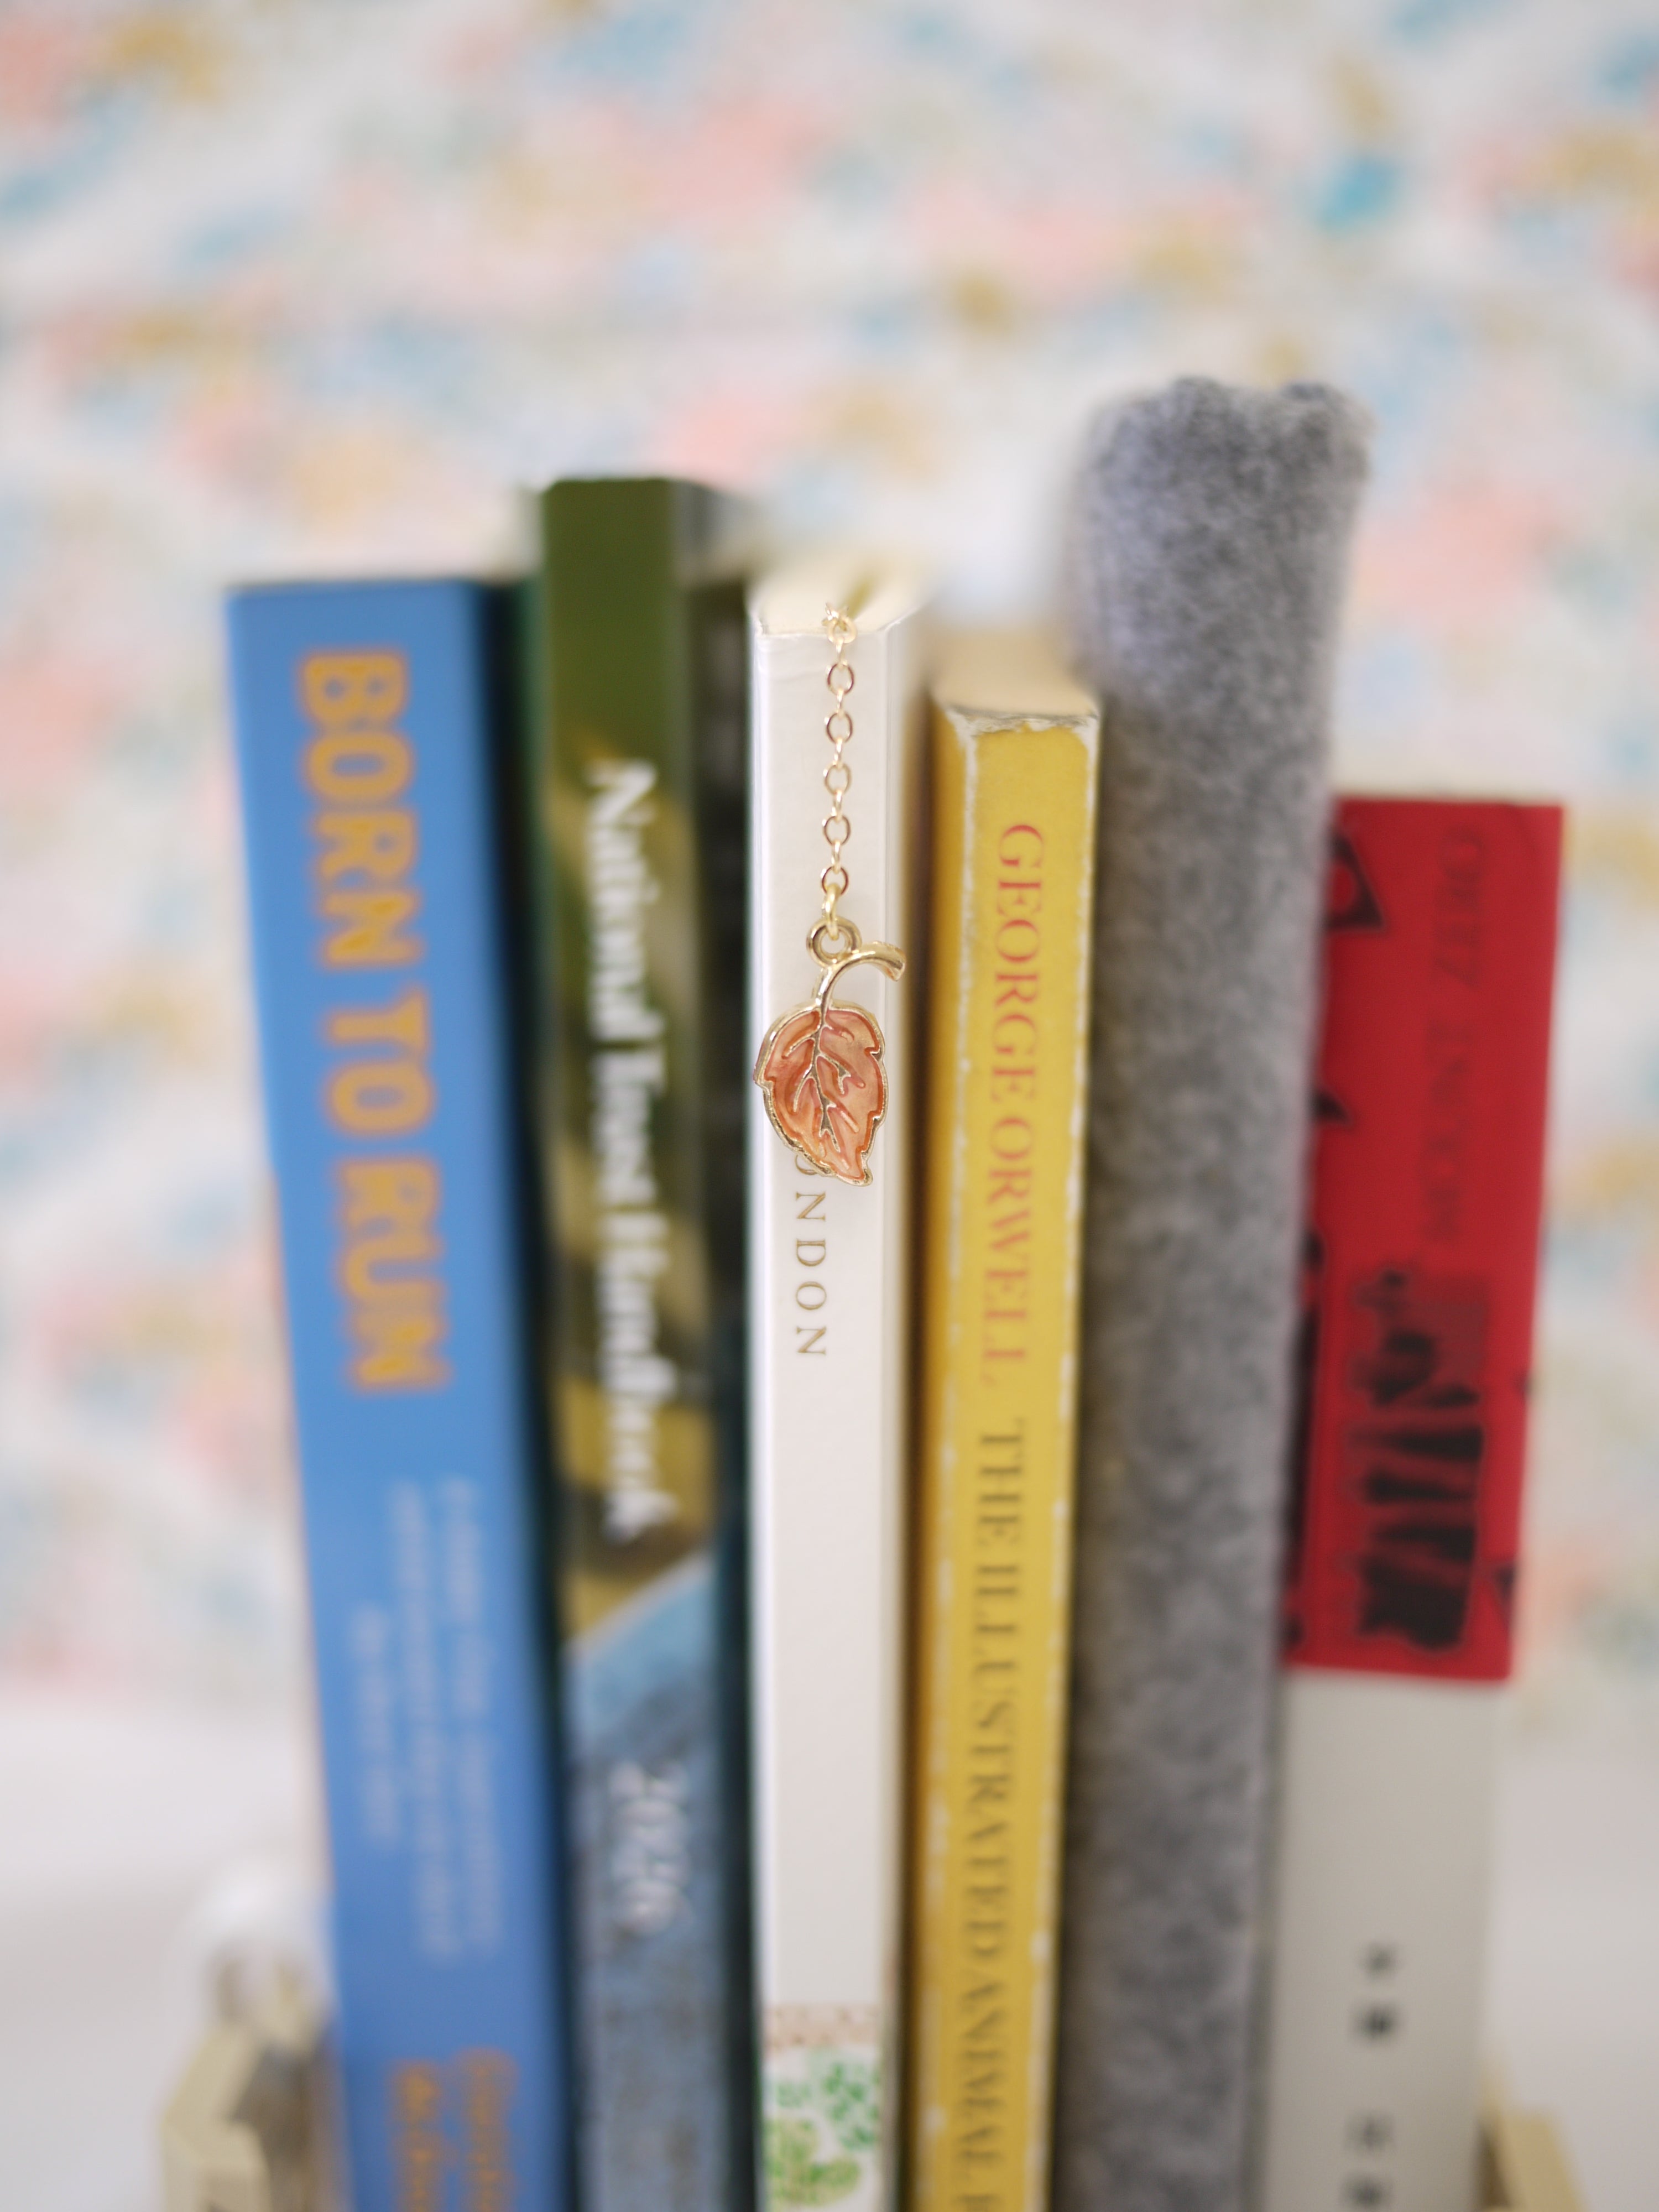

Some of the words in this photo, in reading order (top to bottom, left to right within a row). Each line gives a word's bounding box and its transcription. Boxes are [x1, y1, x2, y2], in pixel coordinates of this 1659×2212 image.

[300, 650, 421, 966] BORN
[589, 761, 664, 1040] National
[325, 989, 433, 1133] TO
[990, 823, 1045, 1101] GEORGE
[338, 1159, 448, 1388] RUN
[982, 1115, 1034, 1384] ORWELL
[975, 1420, 1025, 1543] THE
[963, 1564, 1023, 1956] ILLUSTRATED
[957, 1971, 1010, 2182] ANIMAL
